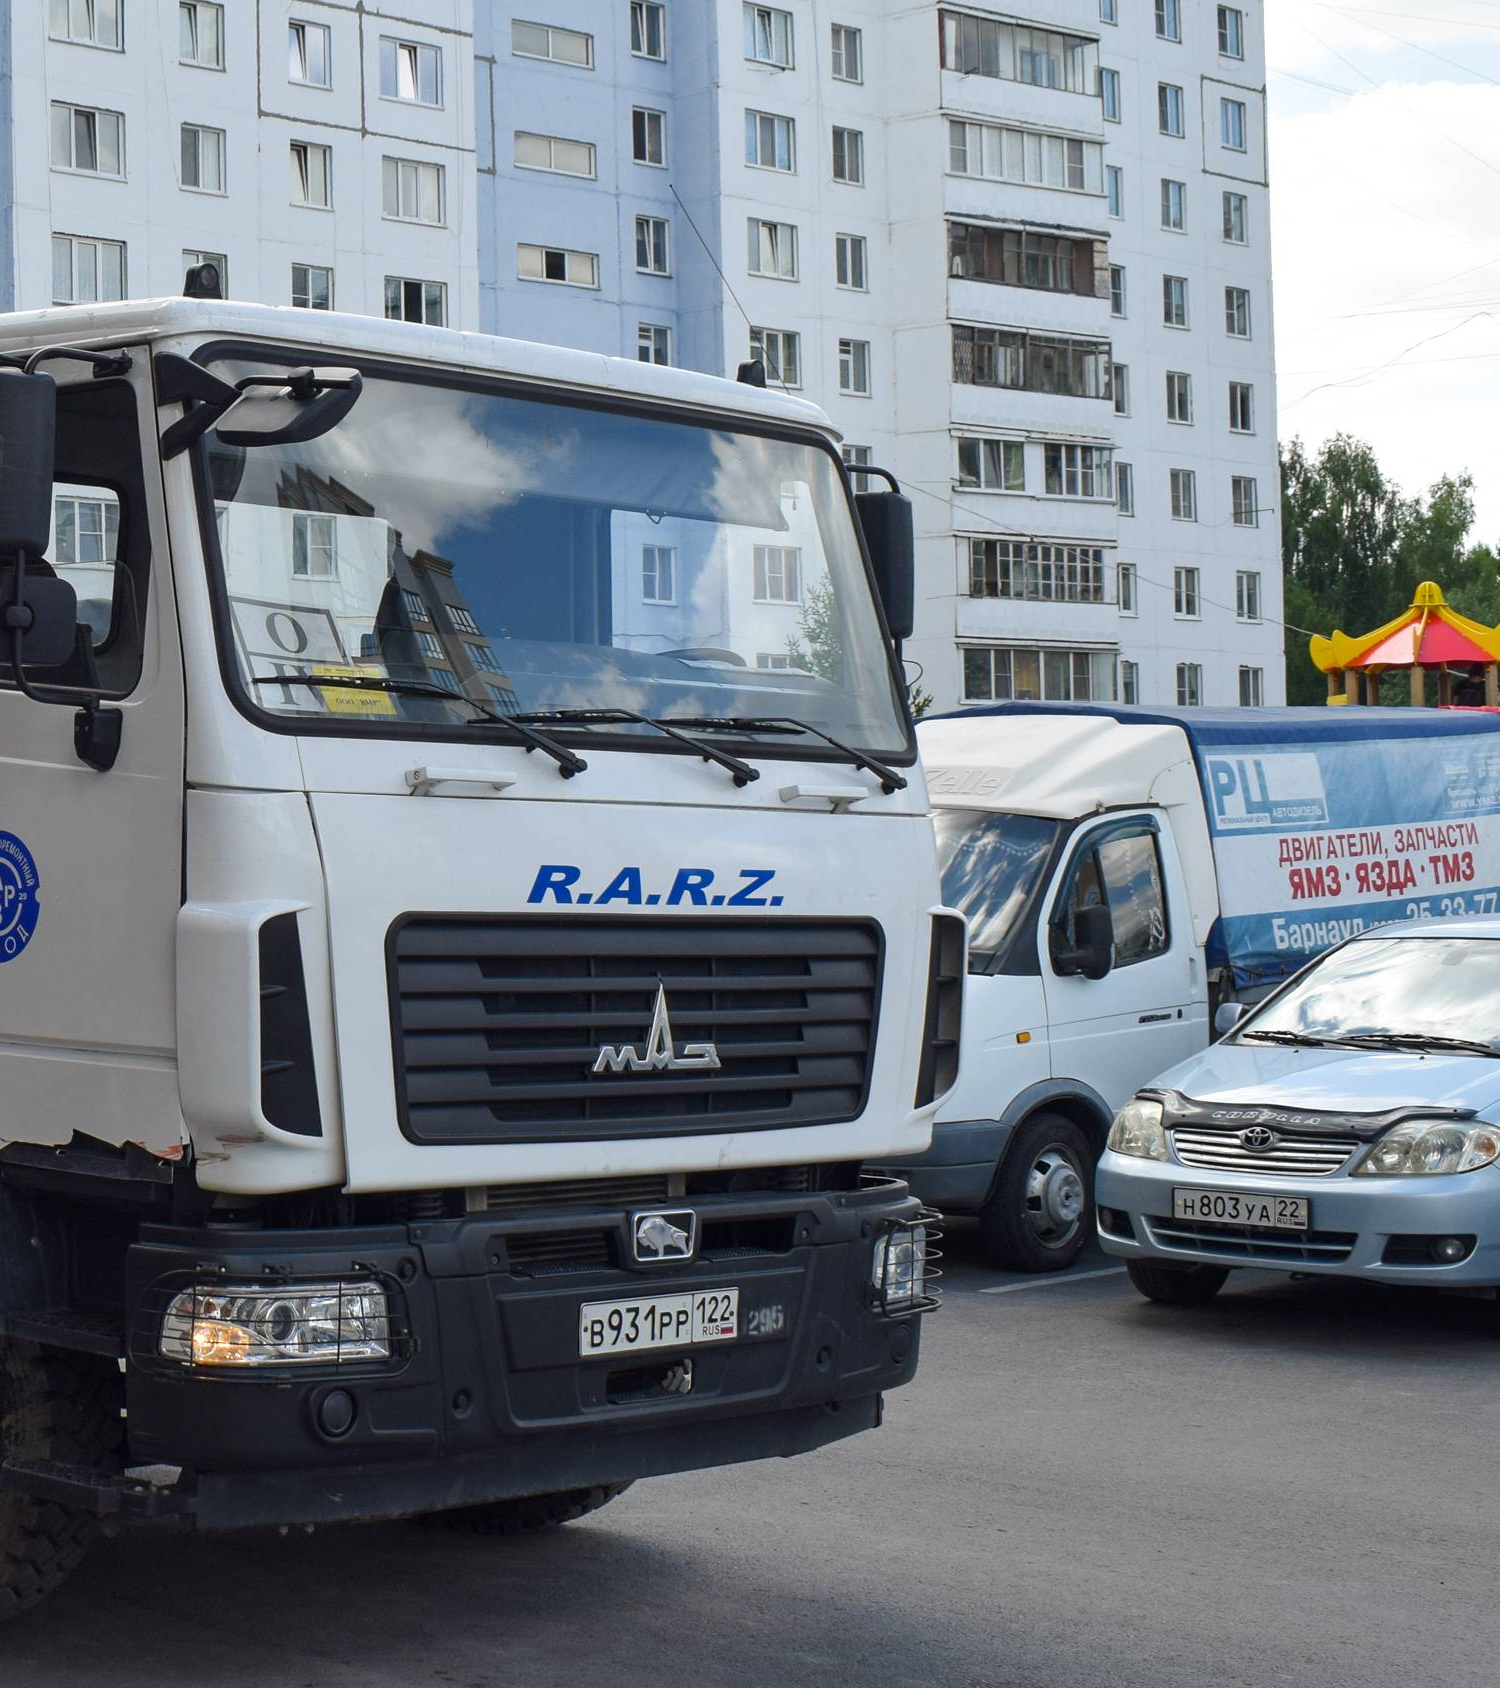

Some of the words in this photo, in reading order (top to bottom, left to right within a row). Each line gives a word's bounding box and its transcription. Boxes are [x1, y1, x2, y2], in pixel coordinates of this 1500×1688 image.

[1278, 830, 1389, 868] ДВИГАТЕЛИ,
[1394, 822, 1479, 854] ЗАПЧАСТИ
[526, 864, 785, 907] R.A.R.Z.
[1288, 864, 1342, 900] ЯМЗ
[1355, 858, 1418, 897] ЯЗДА
[1428, 851, 1476, 885] ТМЗ
[1276, 1216, 1293, 1226] RUS
[1278, 1199, 1300, 1218] 22
[696, 1294, 732, 1325] 122
[701, 1324, 721, 1337] RUS
